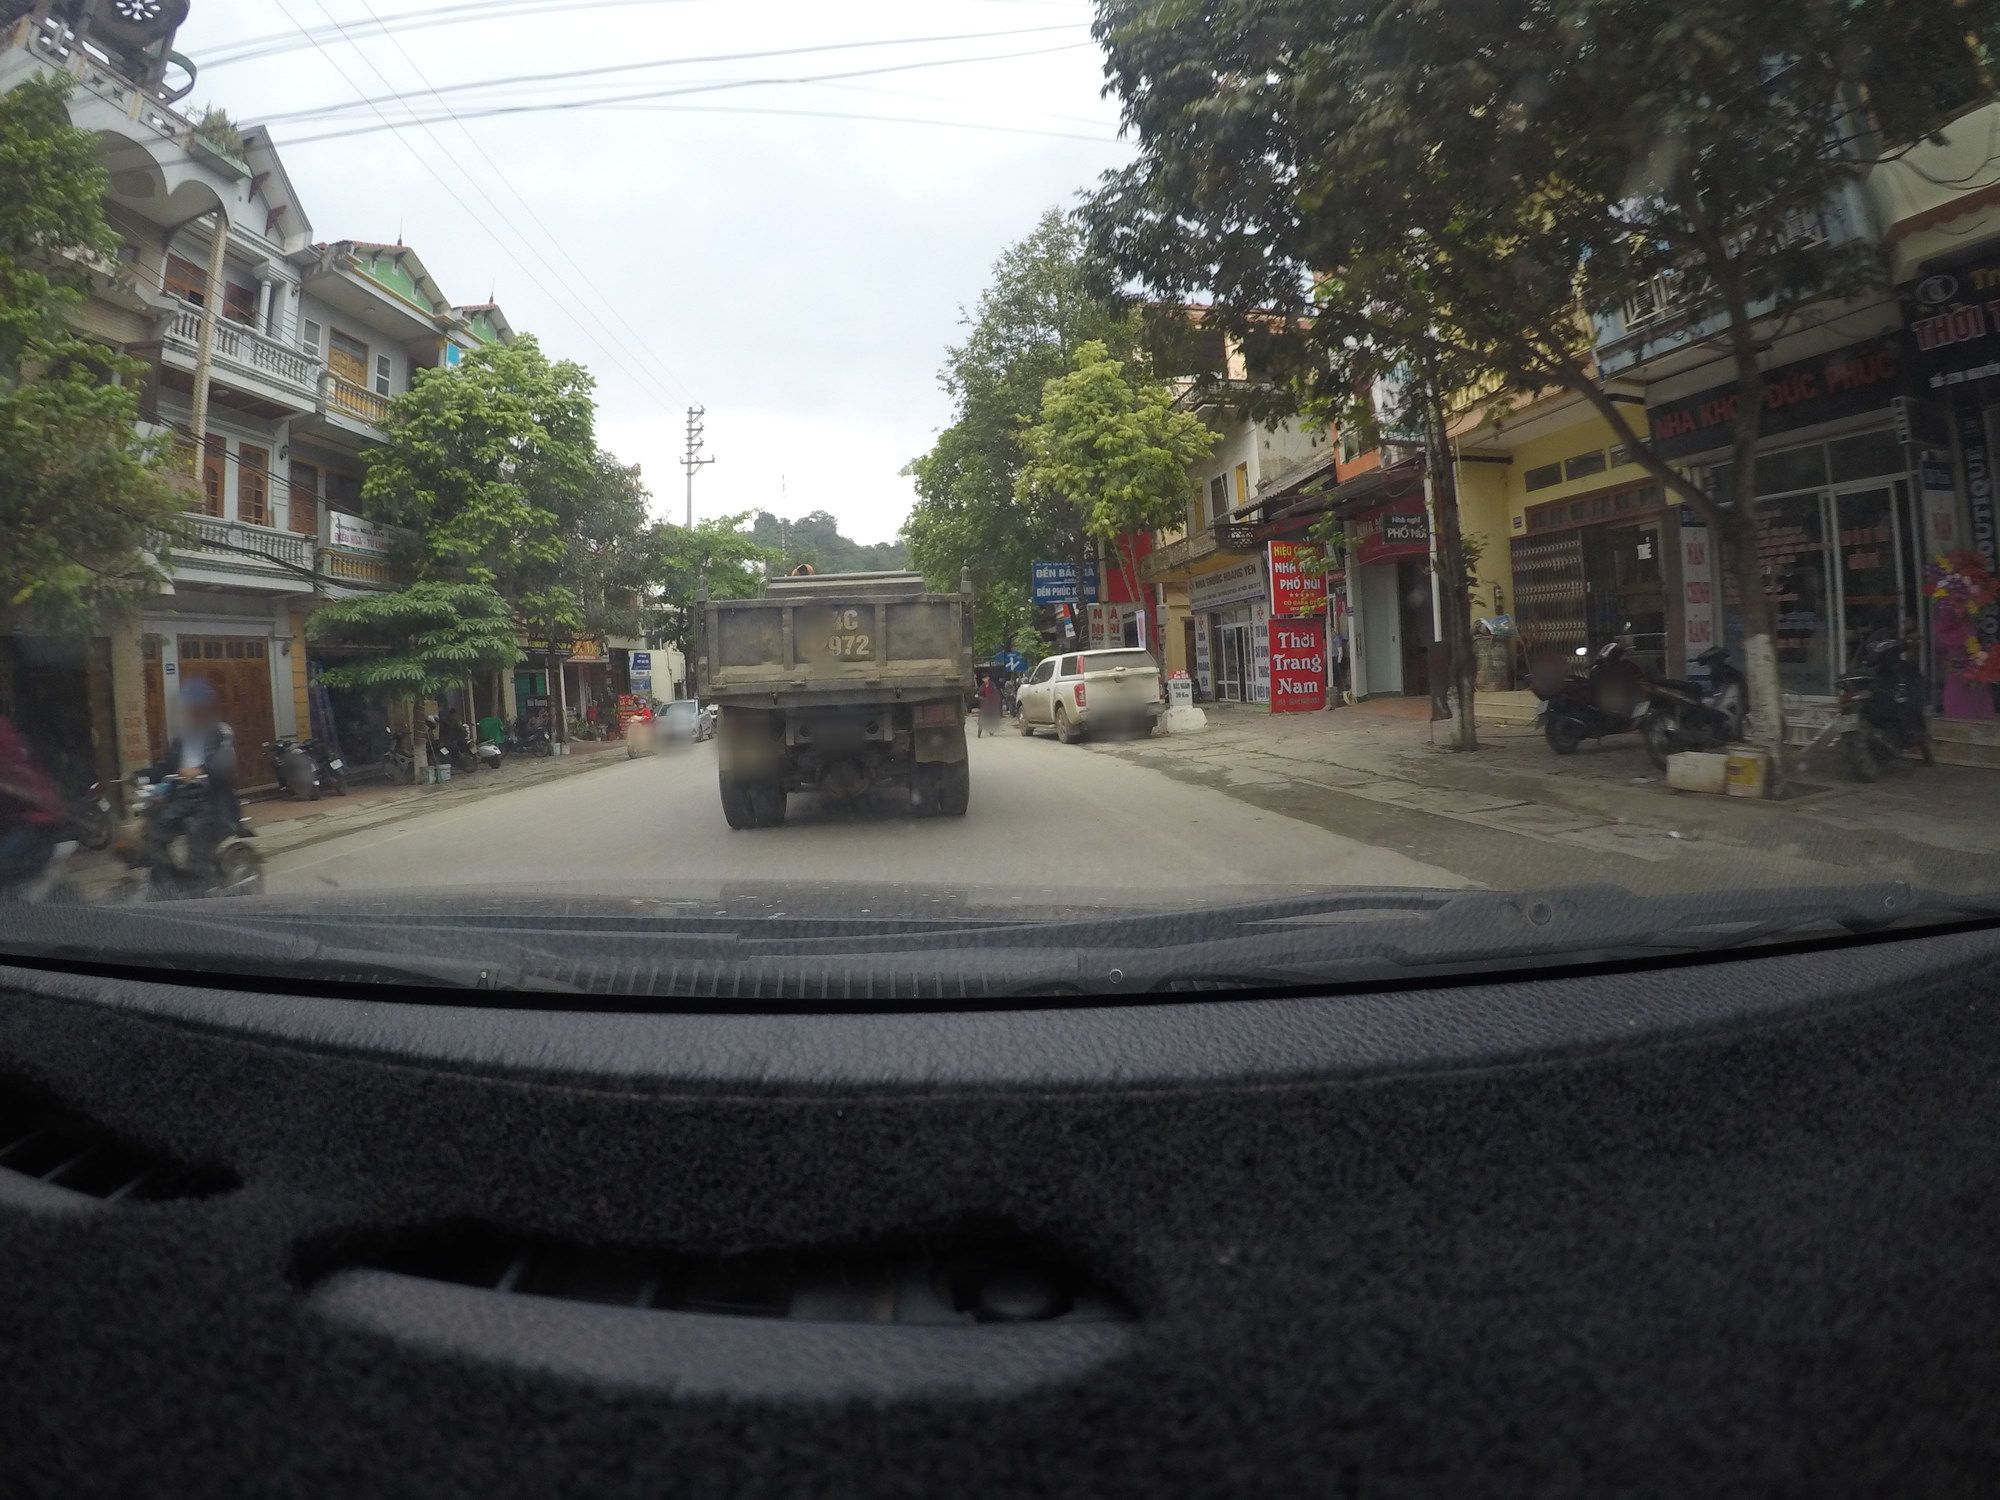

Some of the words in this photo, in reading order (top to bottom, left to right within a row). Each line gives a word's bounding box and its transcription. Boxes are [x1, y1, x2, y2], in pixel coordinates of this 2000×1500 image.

[1387, 525, 1410, 540] PHỐ
[1273, 544, 1292, 558] HIỆU
[1280, 576, 1301, 591] PHỐ
[1277, 632, 1315, 649] Thời
[1272, 654, 1323, 673] Trang
[1277, 678, 1319, 695] Nam
